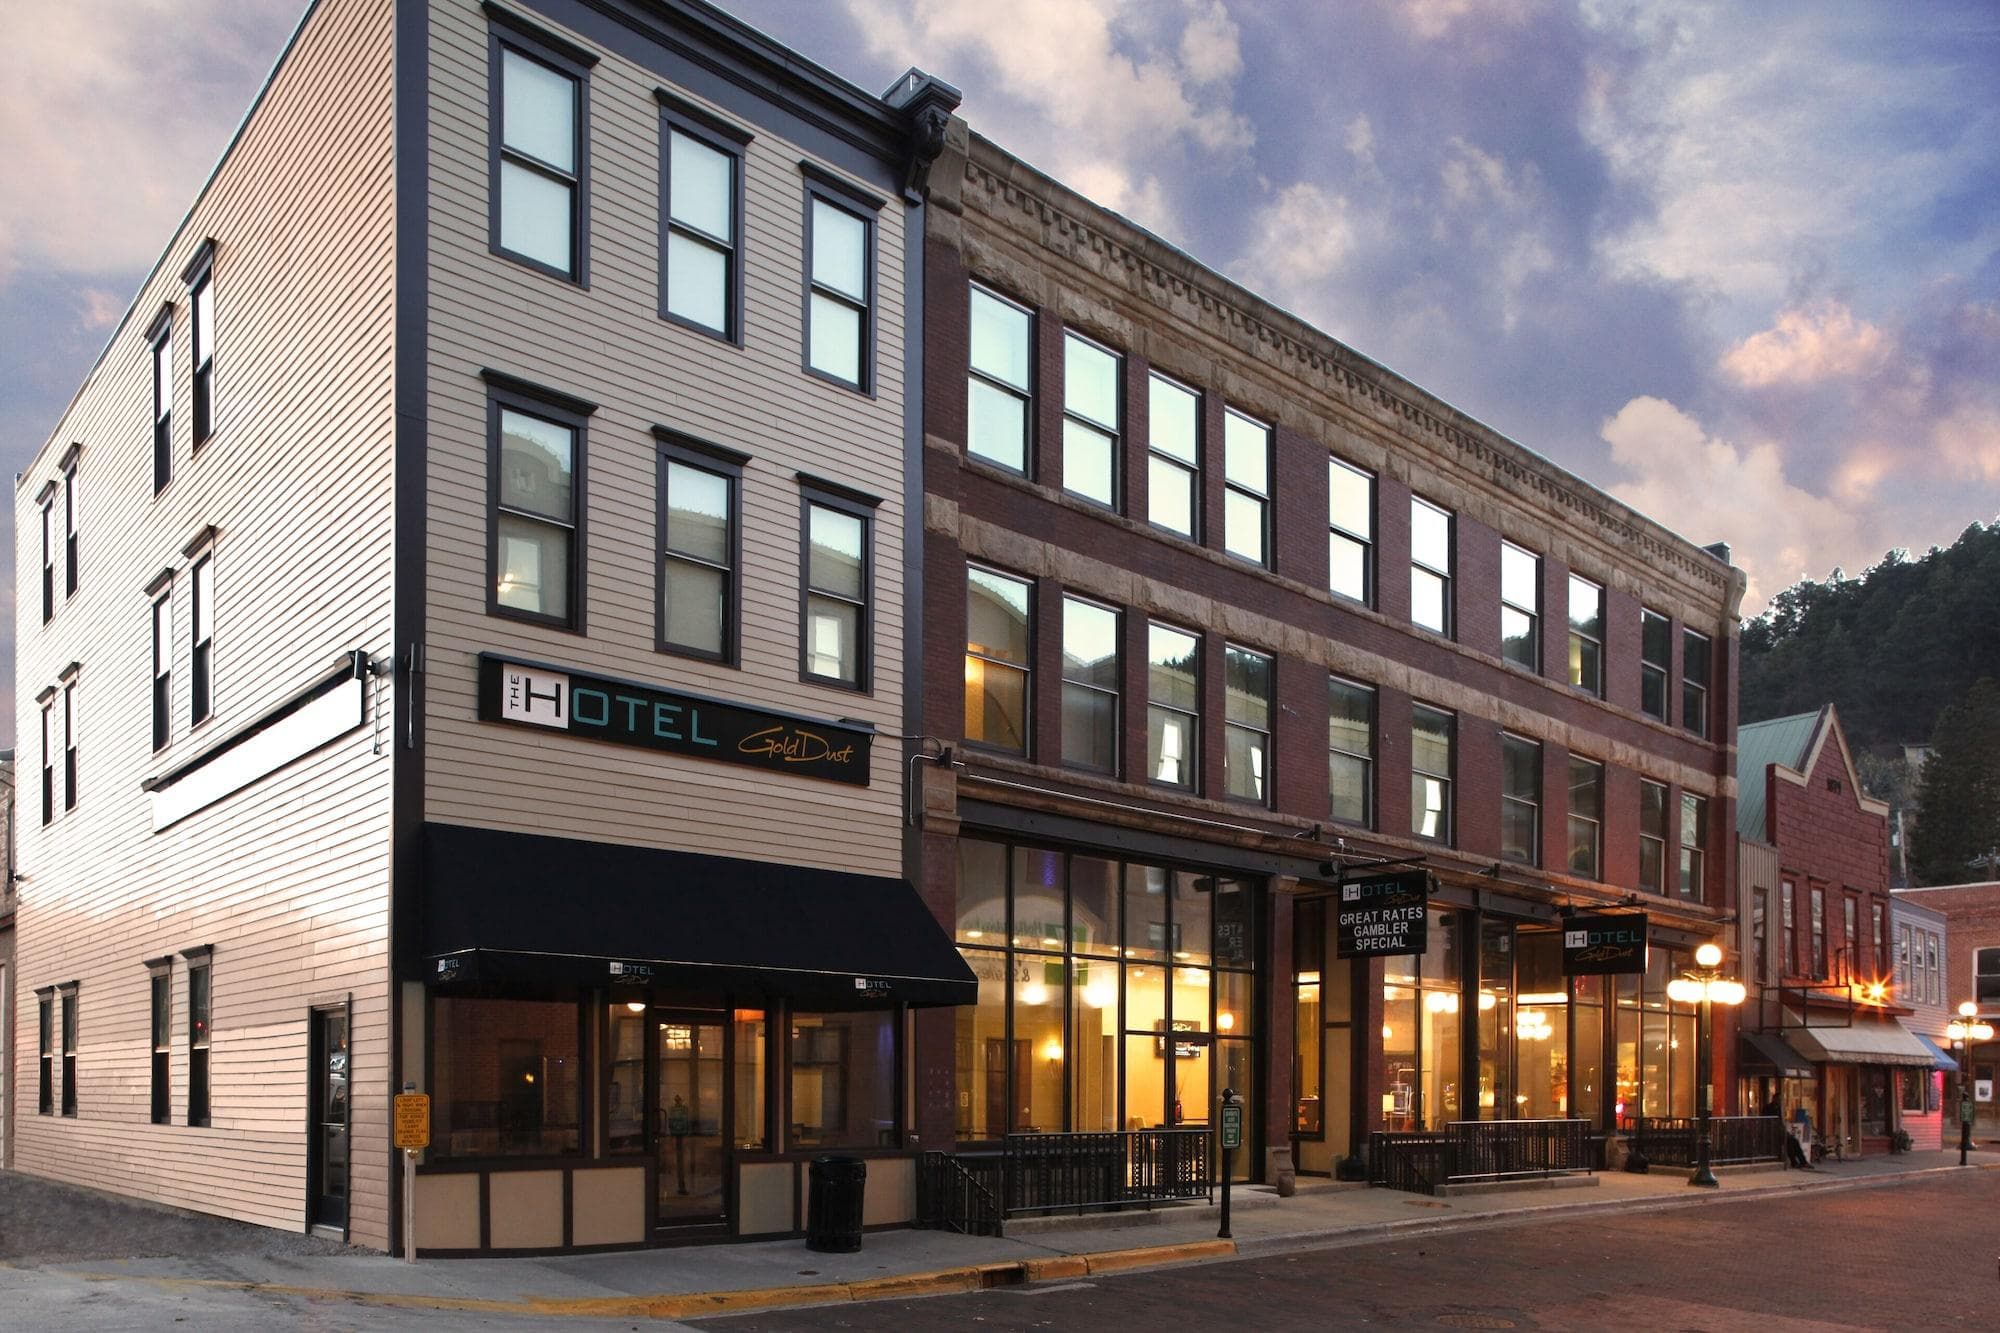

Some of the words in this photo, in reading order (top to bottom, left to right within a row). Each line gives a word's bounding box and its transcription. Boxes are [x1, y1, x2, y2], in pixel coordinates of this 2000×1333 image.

[510, 674, 520, 710] THE
[524, 677, 718, 746] HOTEL
[737, 726, 800, 759] Gold
[785, 729, 854, 763] Dust
[1348, 880, 1406, 898] HOTEL
[1339, 910, 1379, 925] GREAT
[1382, 906, 1424, 922] RATES
[1353, 921, 1409, 938] GAMBLER
[1572, 929, 1642, 945] HOTEL
[1355, 935, 1406, 950] SPECIAL
[613, 963, 655, 975] HOTEL
